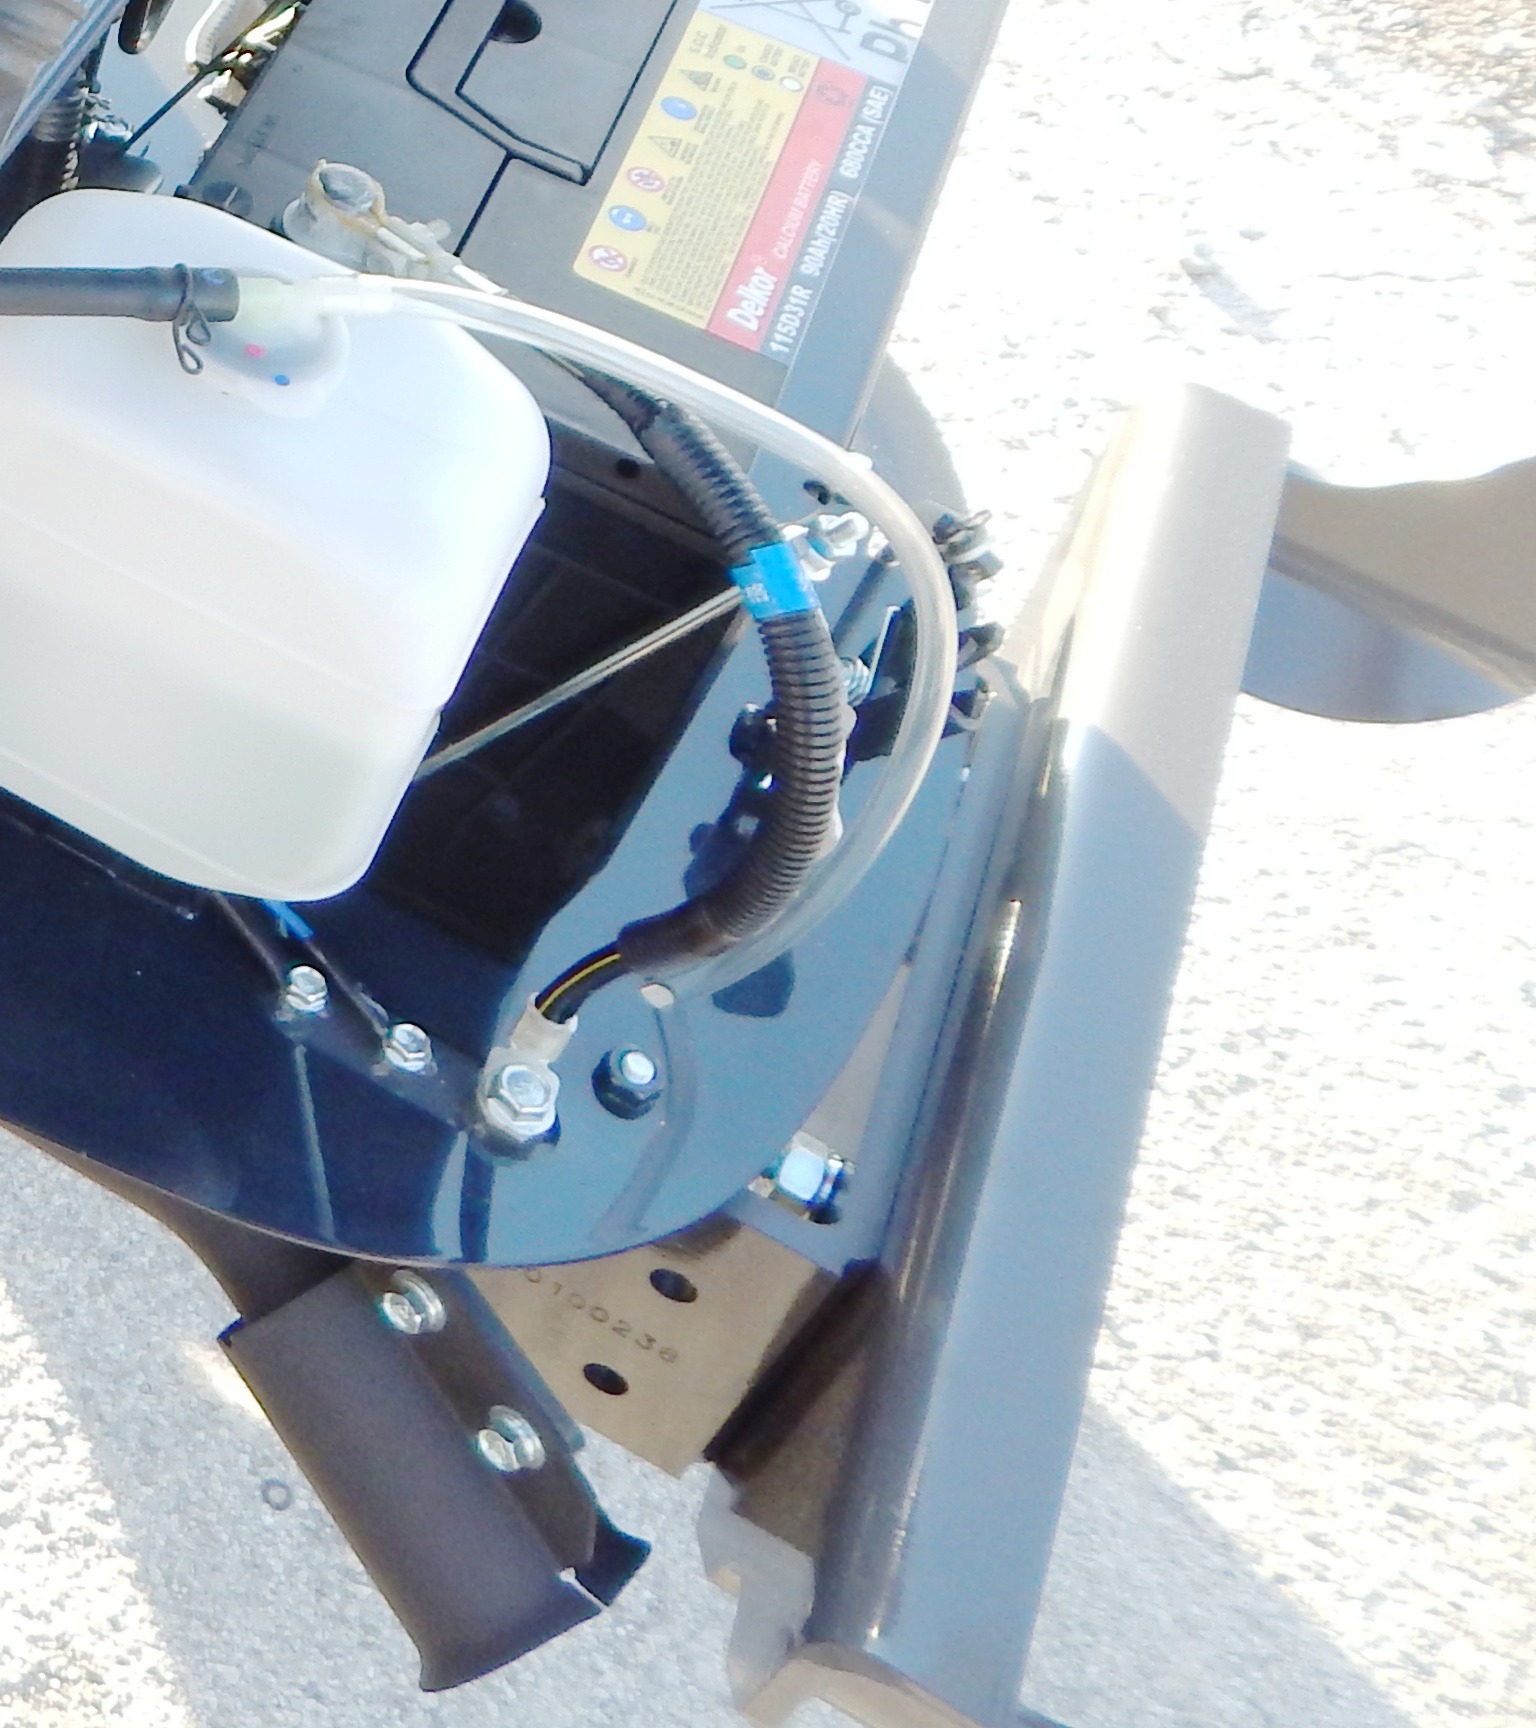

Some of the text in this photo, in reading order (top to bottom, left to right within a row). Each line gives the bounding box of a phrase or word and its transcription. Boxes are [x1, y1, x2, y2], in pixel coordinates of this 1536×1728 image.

[791, 156, 826, 209] BATTERY
[766, 282, 815, 356] 115D31R
[837, 121, 879, 181] 680CCA
[858, 81, 895, 126] (SAE)
[724, 261, 781, 332] Delkor
